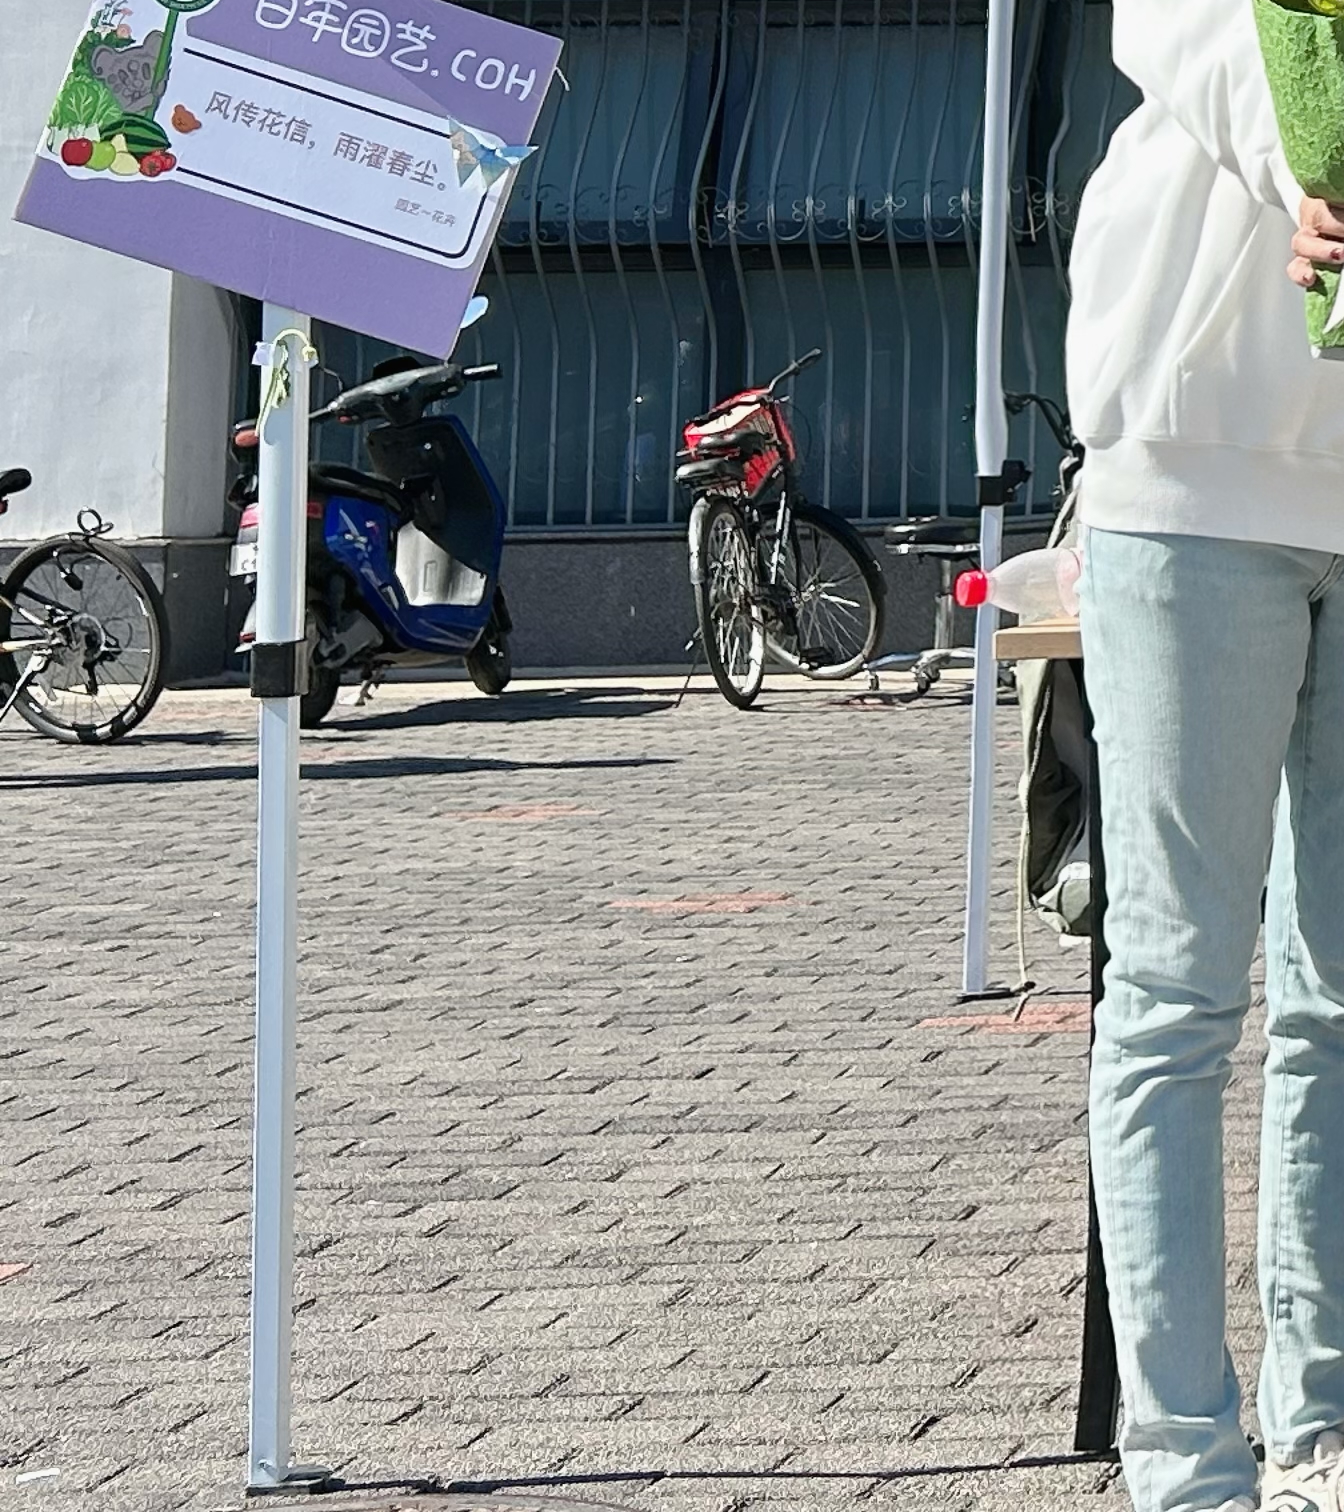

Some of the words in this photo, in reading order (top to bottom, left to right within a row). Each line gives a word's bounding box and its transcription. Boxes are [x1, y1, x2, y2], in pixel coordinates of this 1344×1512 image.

[205, 90, 447, 192] 风传花信，雨濯春尘。
